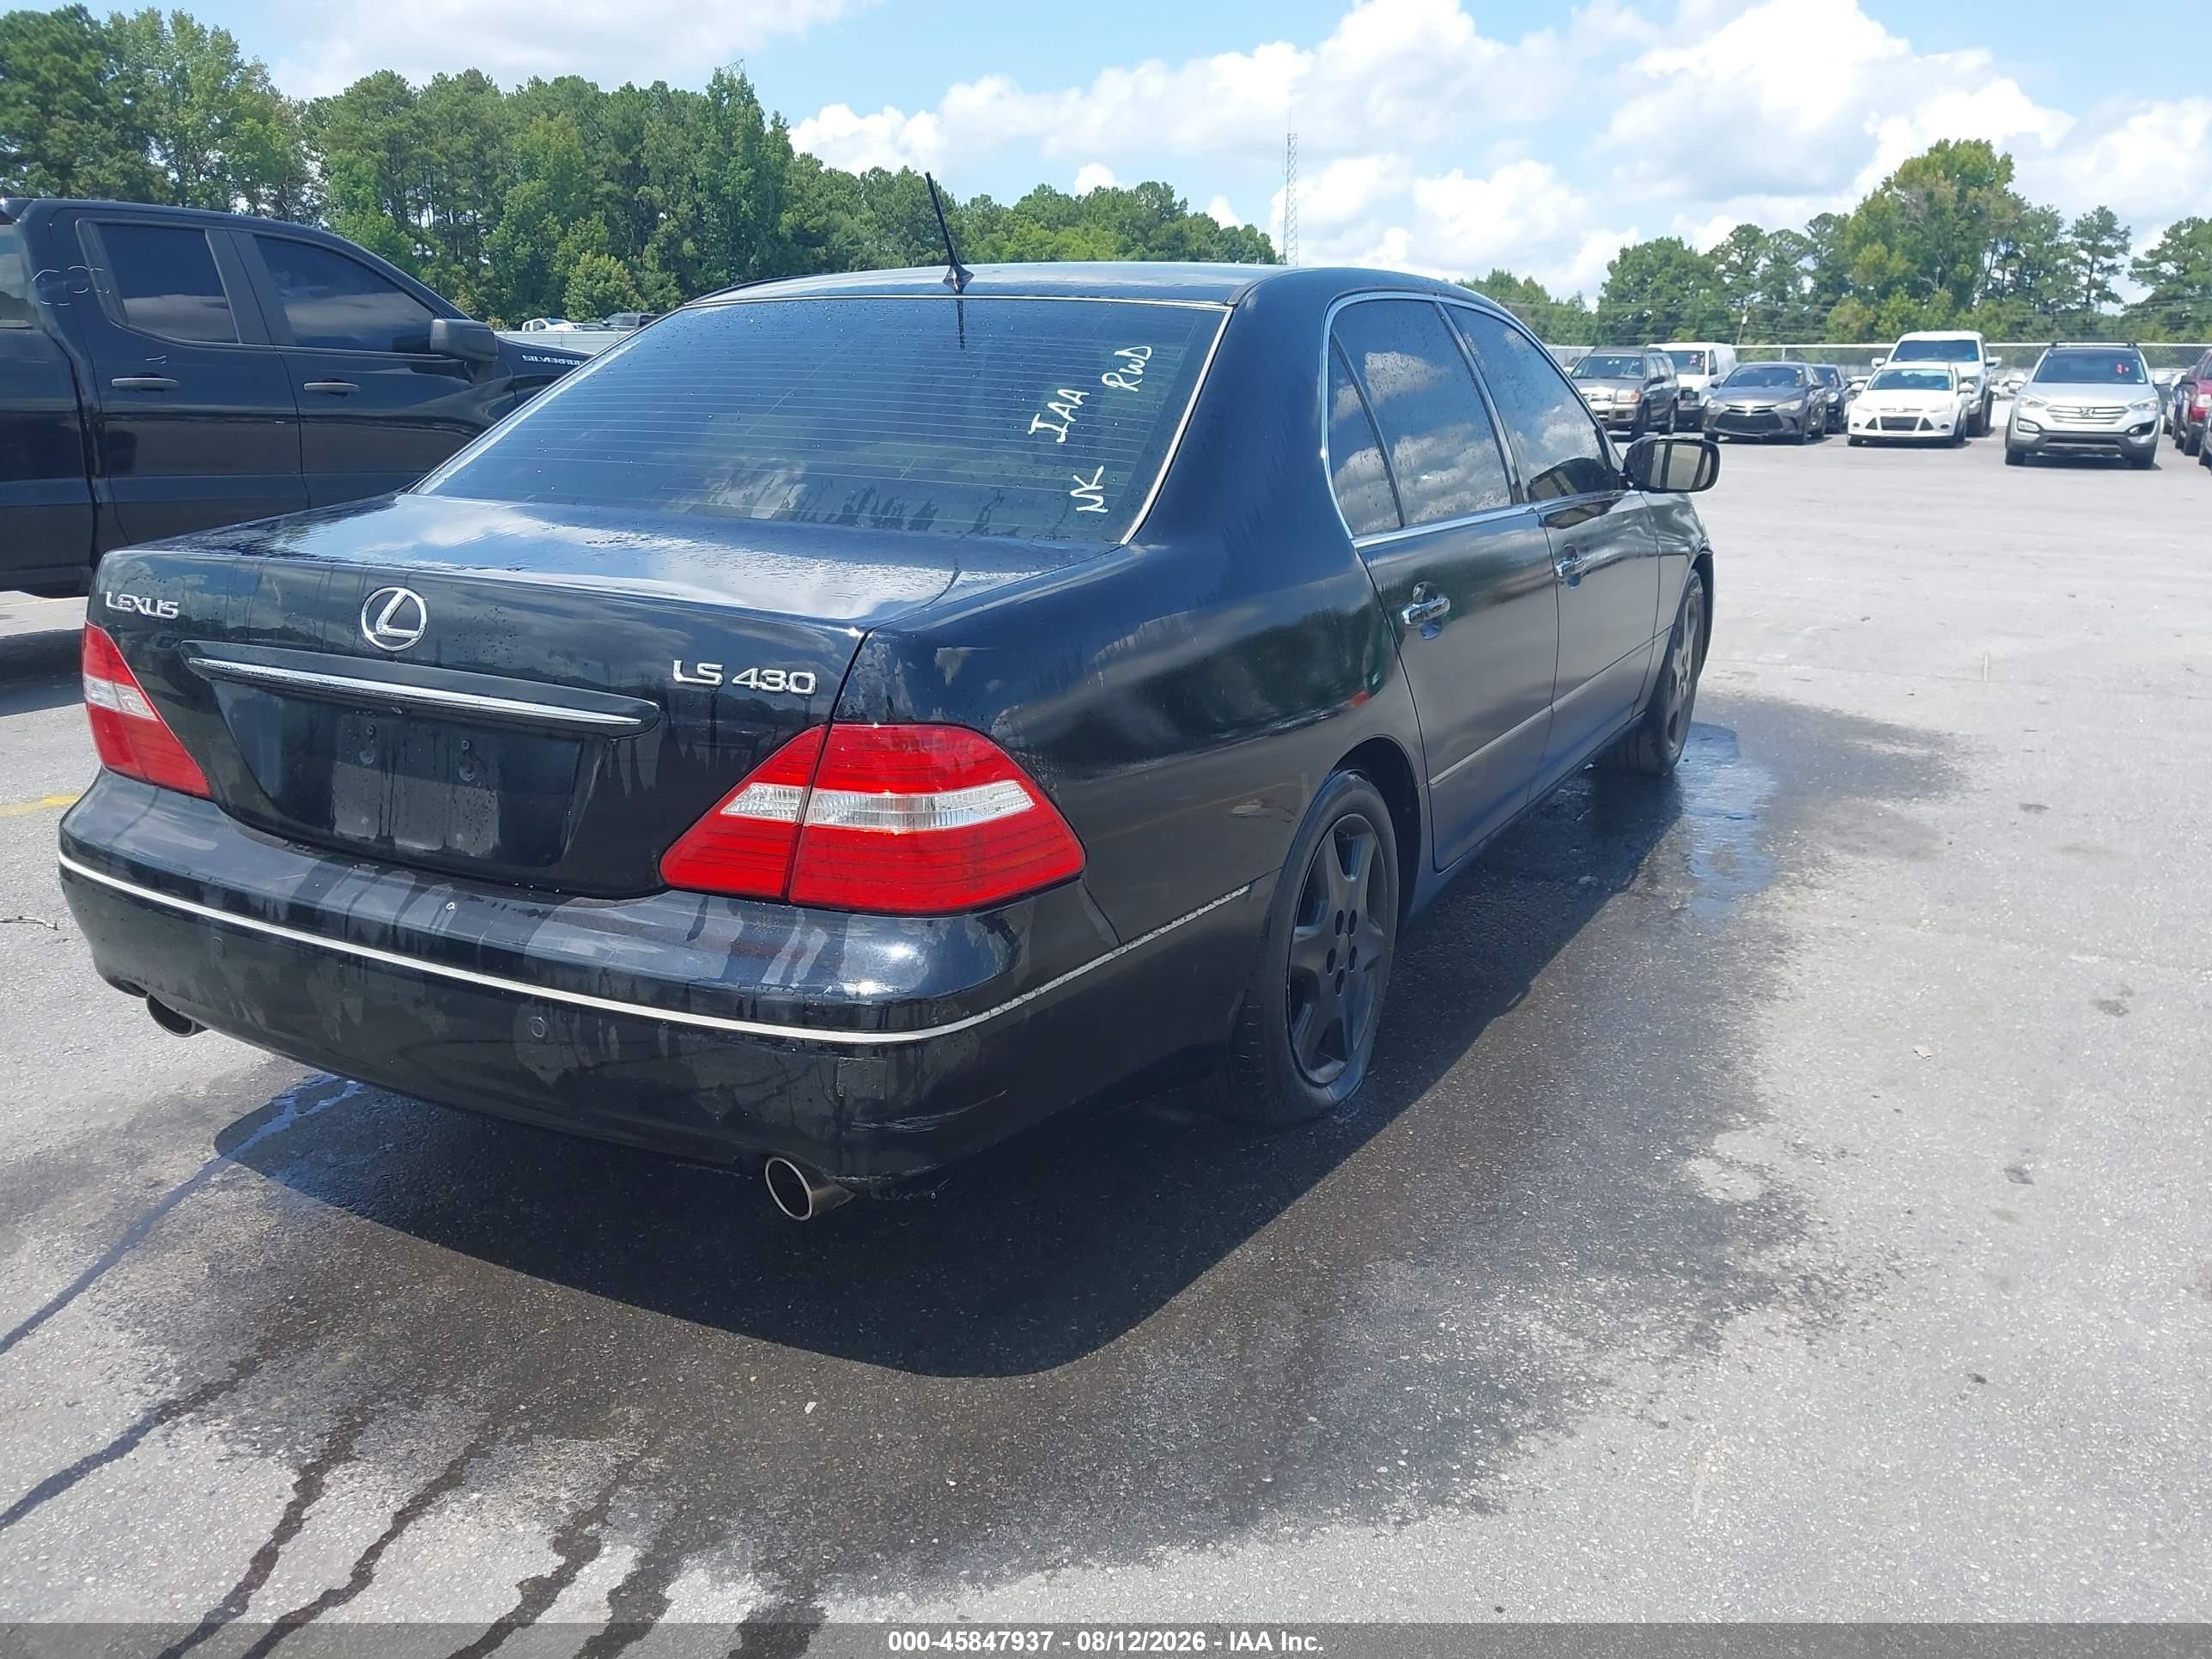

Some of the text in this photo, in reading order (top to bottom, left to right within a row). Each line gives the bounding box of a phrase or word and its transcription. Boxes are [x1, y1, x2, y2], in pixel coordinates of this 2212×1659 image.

[1028, 388, 1091, 443] IAA
[106, 591, 179, 619] LEXUS
[673, 659, 817, 695] LS 430
